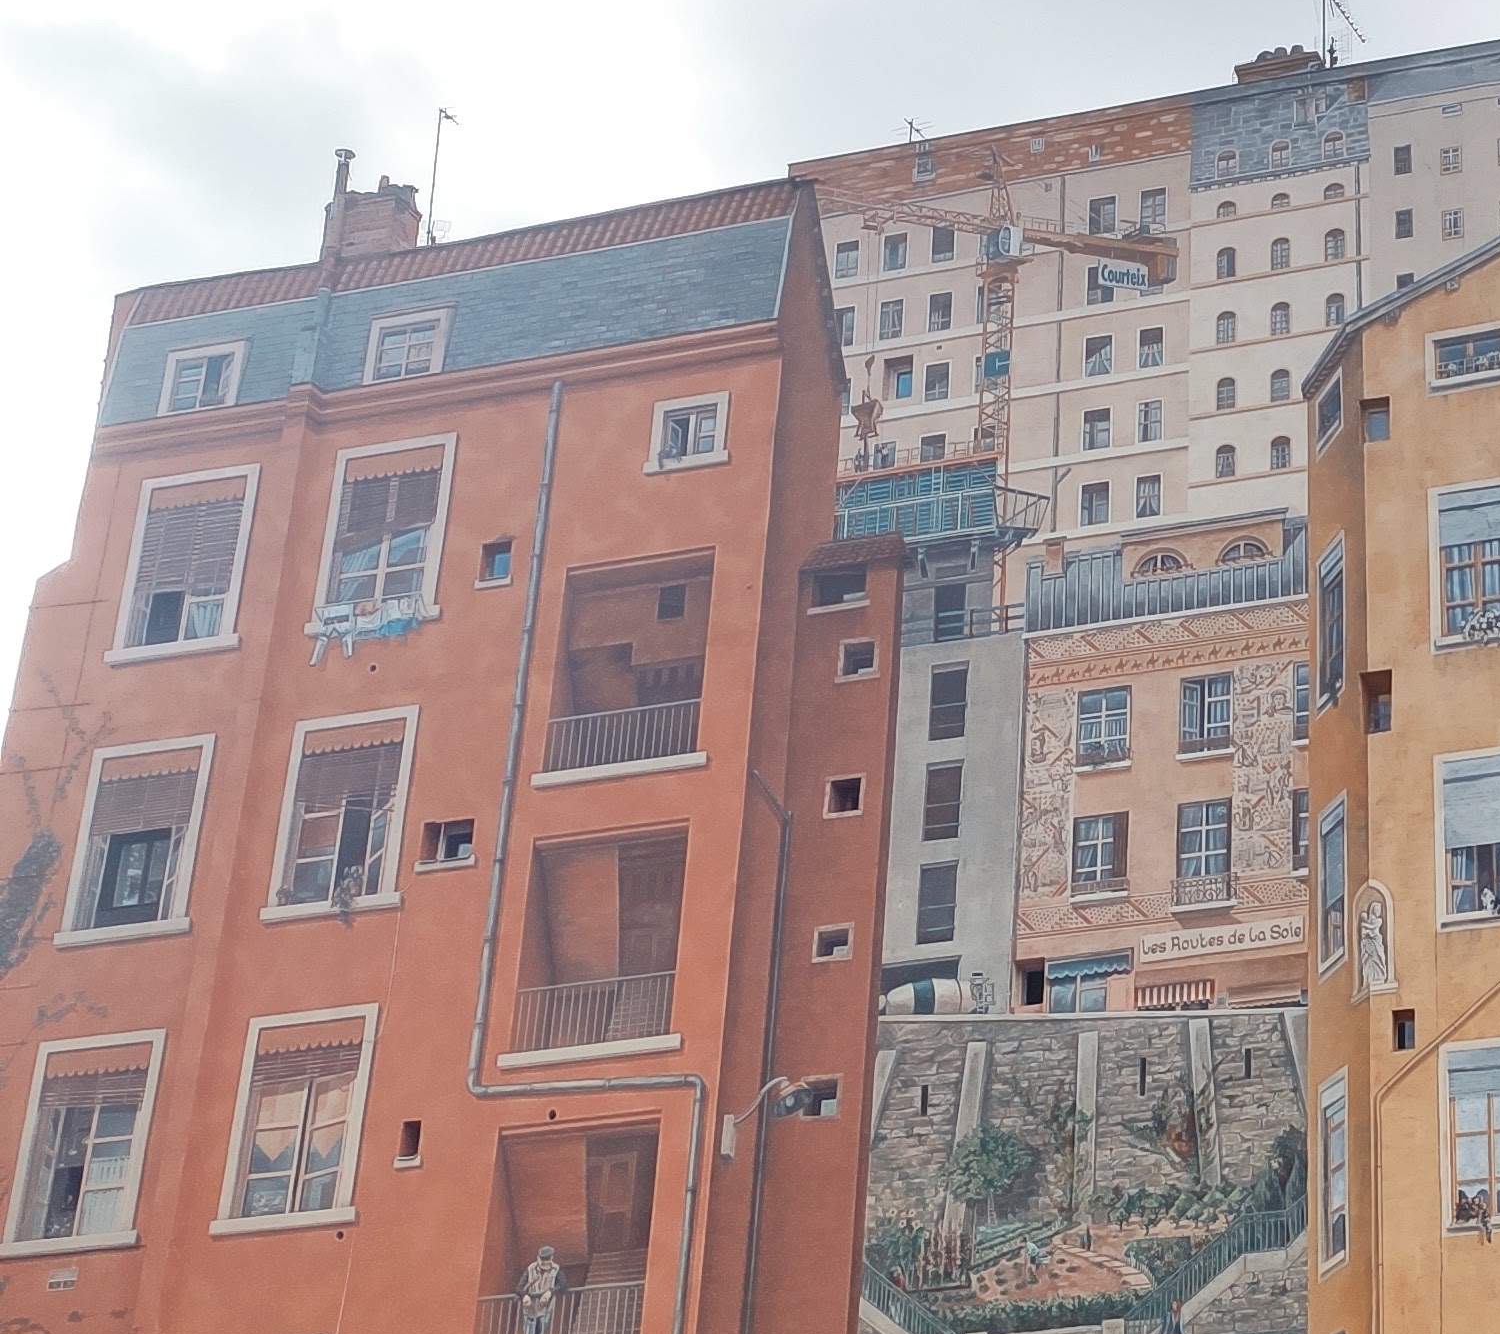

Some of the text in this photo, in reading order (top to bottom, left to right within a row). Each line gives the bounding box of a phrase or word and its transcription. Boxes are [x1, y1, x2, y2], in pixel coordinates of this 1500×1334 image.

[1101, 263, 1146, 287] Courteix
[1171, 932, 1224, 953] Routes
[1228, 929, 1246, 945] de
[1269, 921, 1302, 940] Soie
